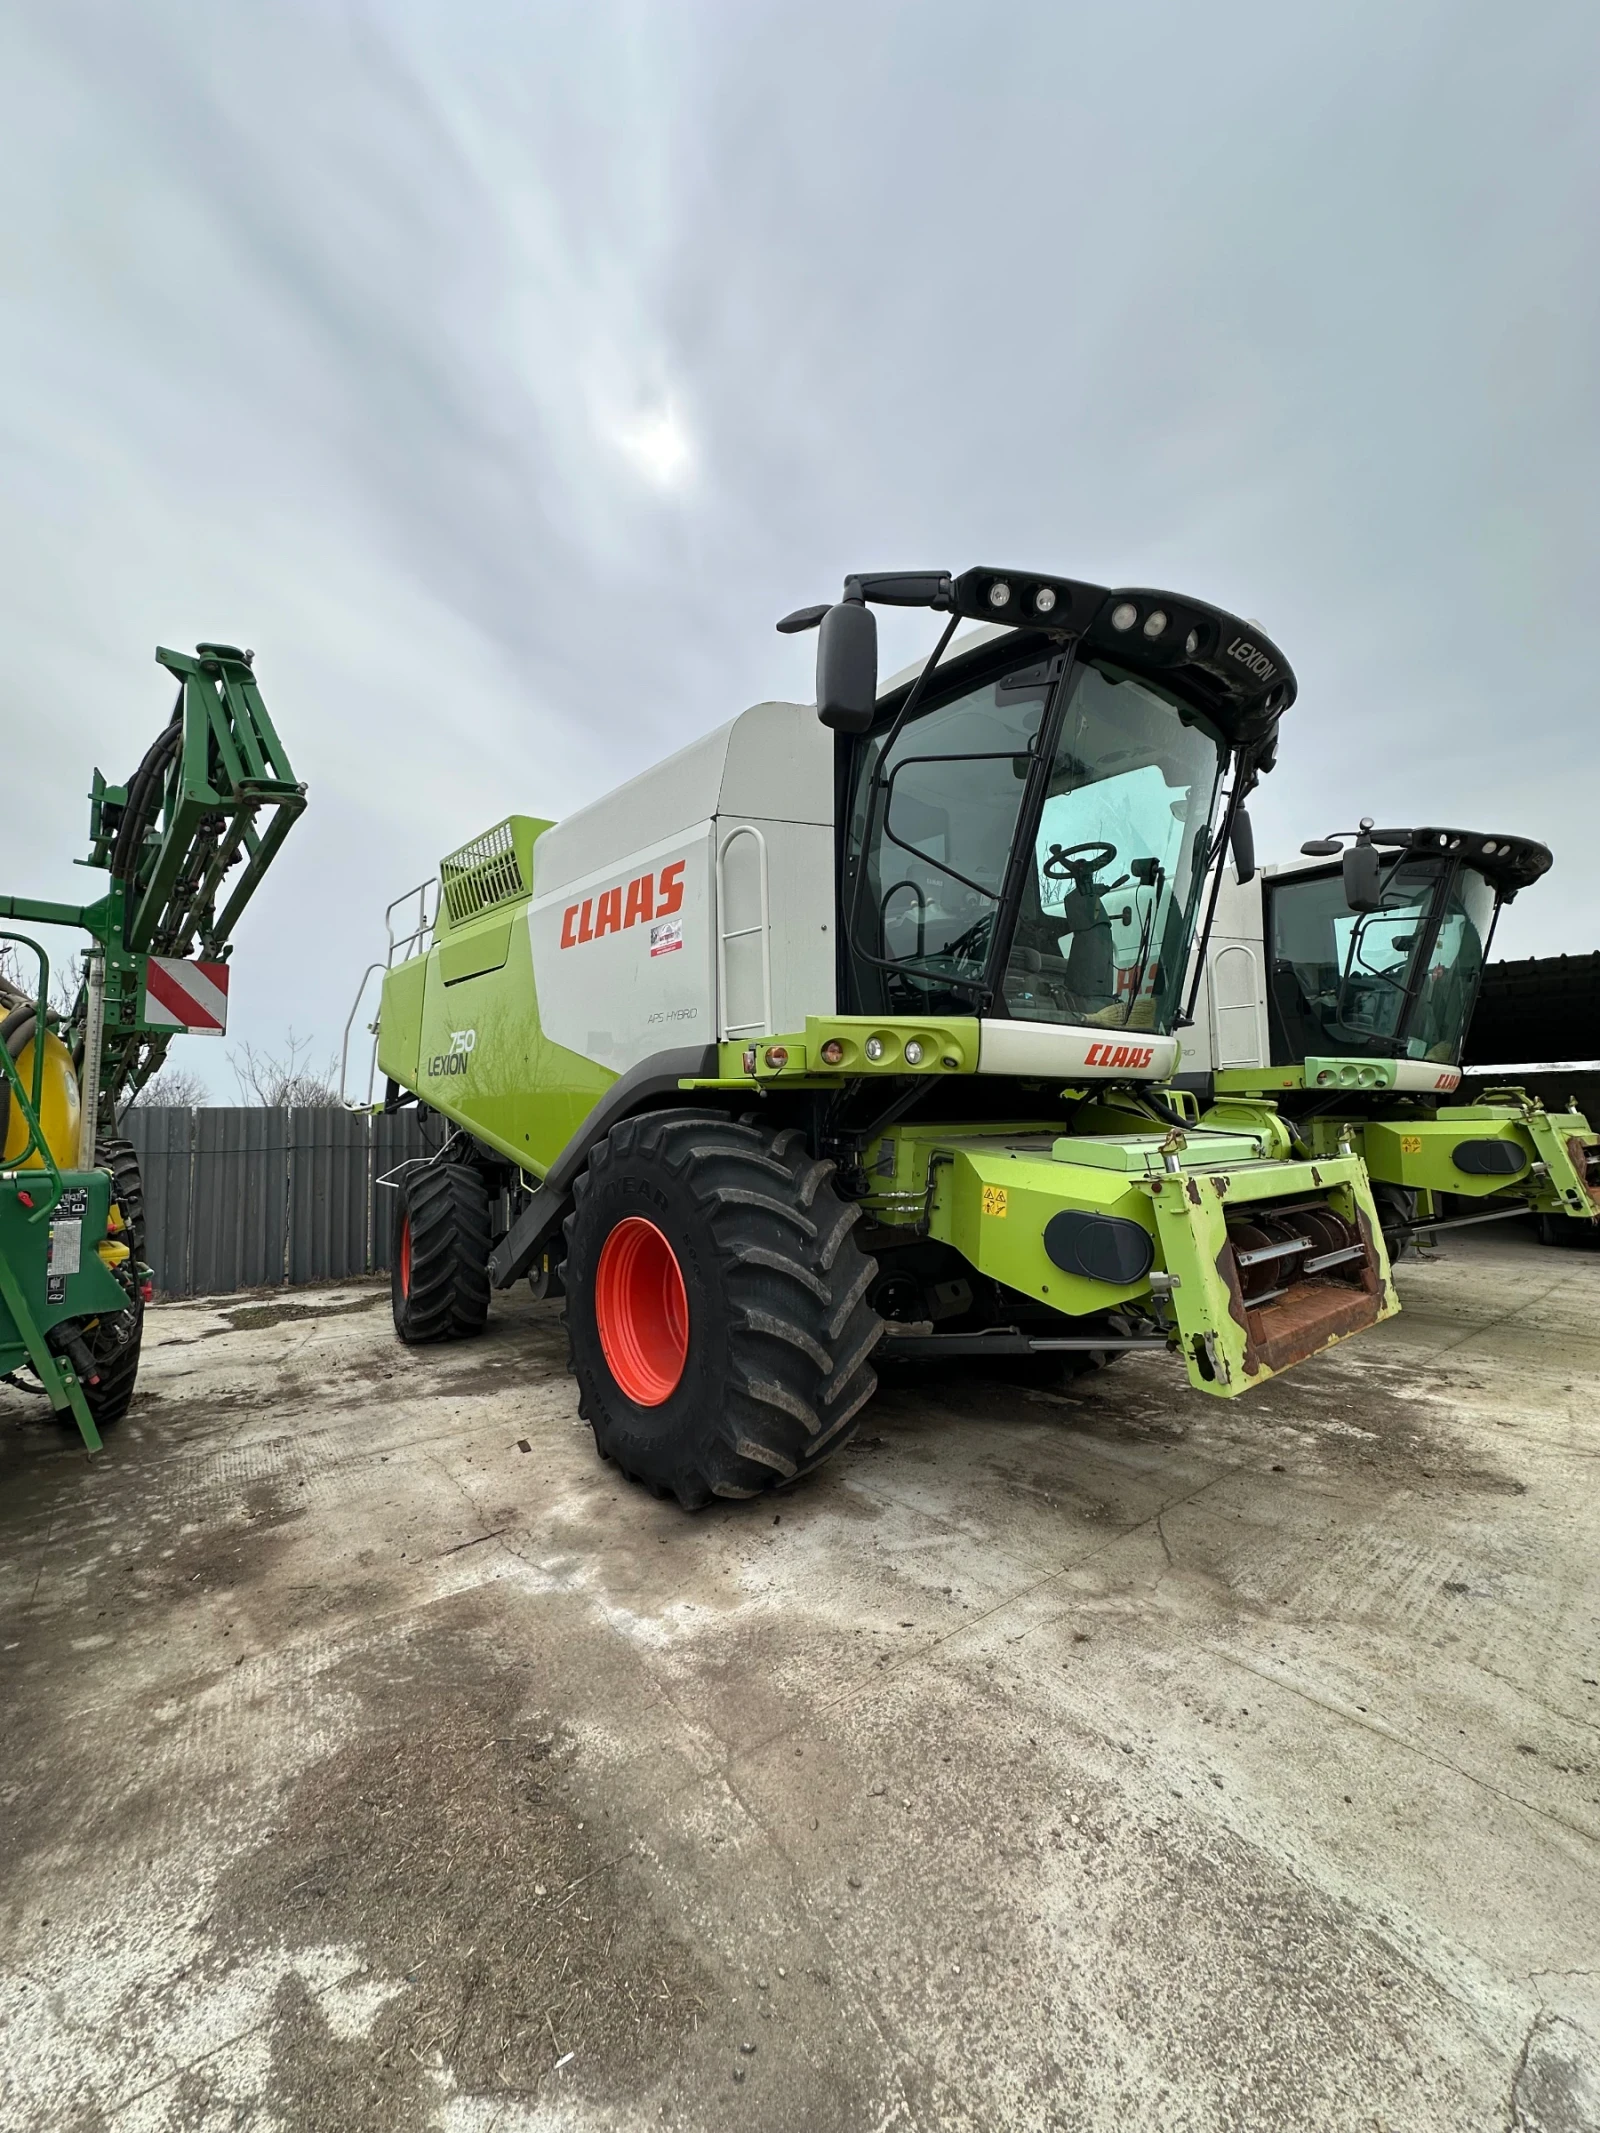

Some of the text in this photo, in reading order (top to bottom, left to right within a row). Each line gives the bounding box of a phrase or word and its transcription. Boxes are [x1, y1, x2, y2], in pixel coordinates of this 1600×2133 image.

[1227, 637, 1277, 682] LEXION
[560, 859, 686, 950] CLAAS
[647, 1012, 664, 1024] APS
[449, 1029, 476, 1055] 750
[428, 1053, 468, 1077] LEXION
[1084, 1043, 1154, 1069] CLAAS
